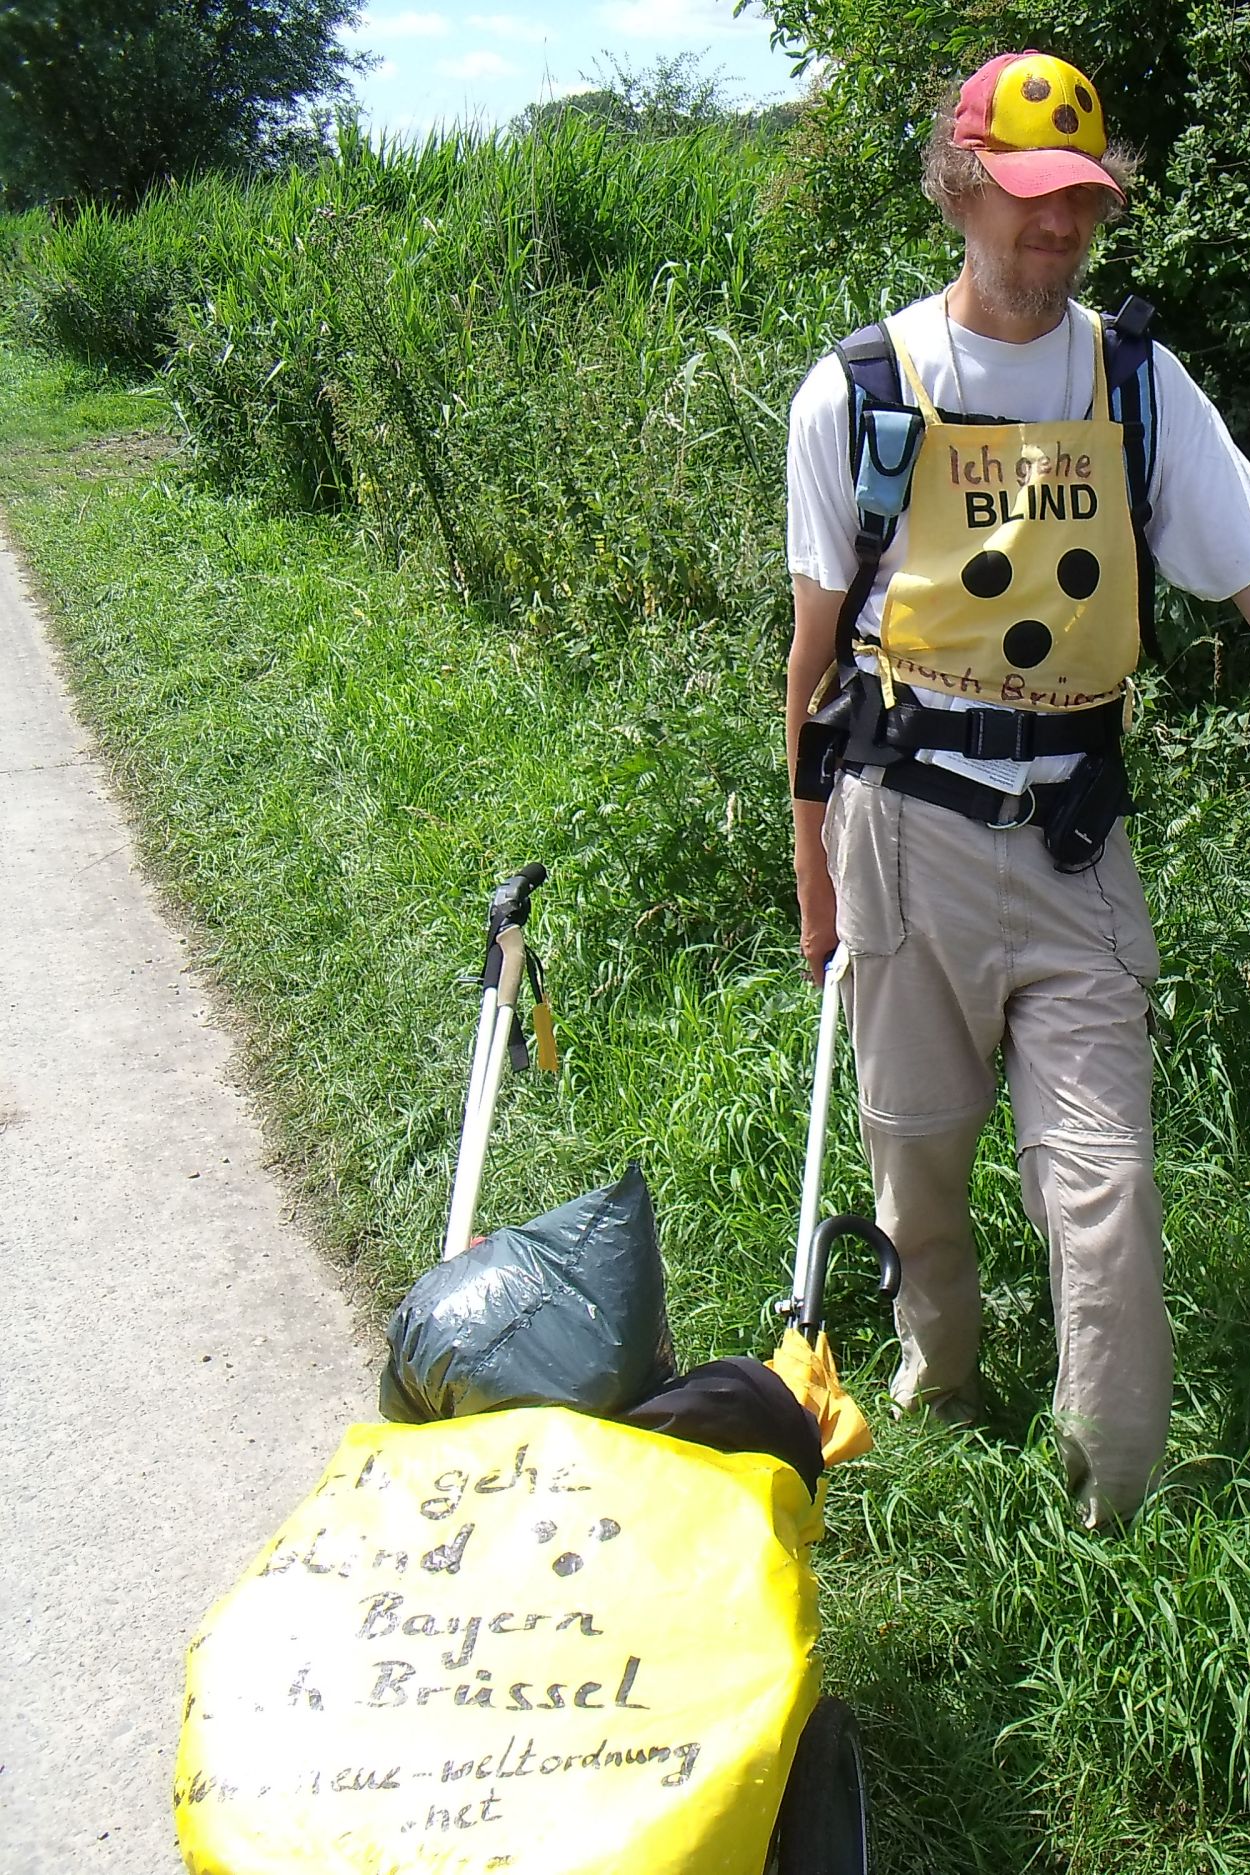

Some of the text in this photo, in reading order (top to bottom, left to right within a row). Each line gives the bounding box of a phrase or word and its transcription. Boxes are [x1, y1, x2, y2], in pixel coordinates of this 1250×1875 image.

[949, 440, 1092, 486] Ich gehe
[964, 483, 1098, 529] BLIND
[355, 1591, 605, 1670] Bayern
[354, 1655, 651, 1712] Brüssel
